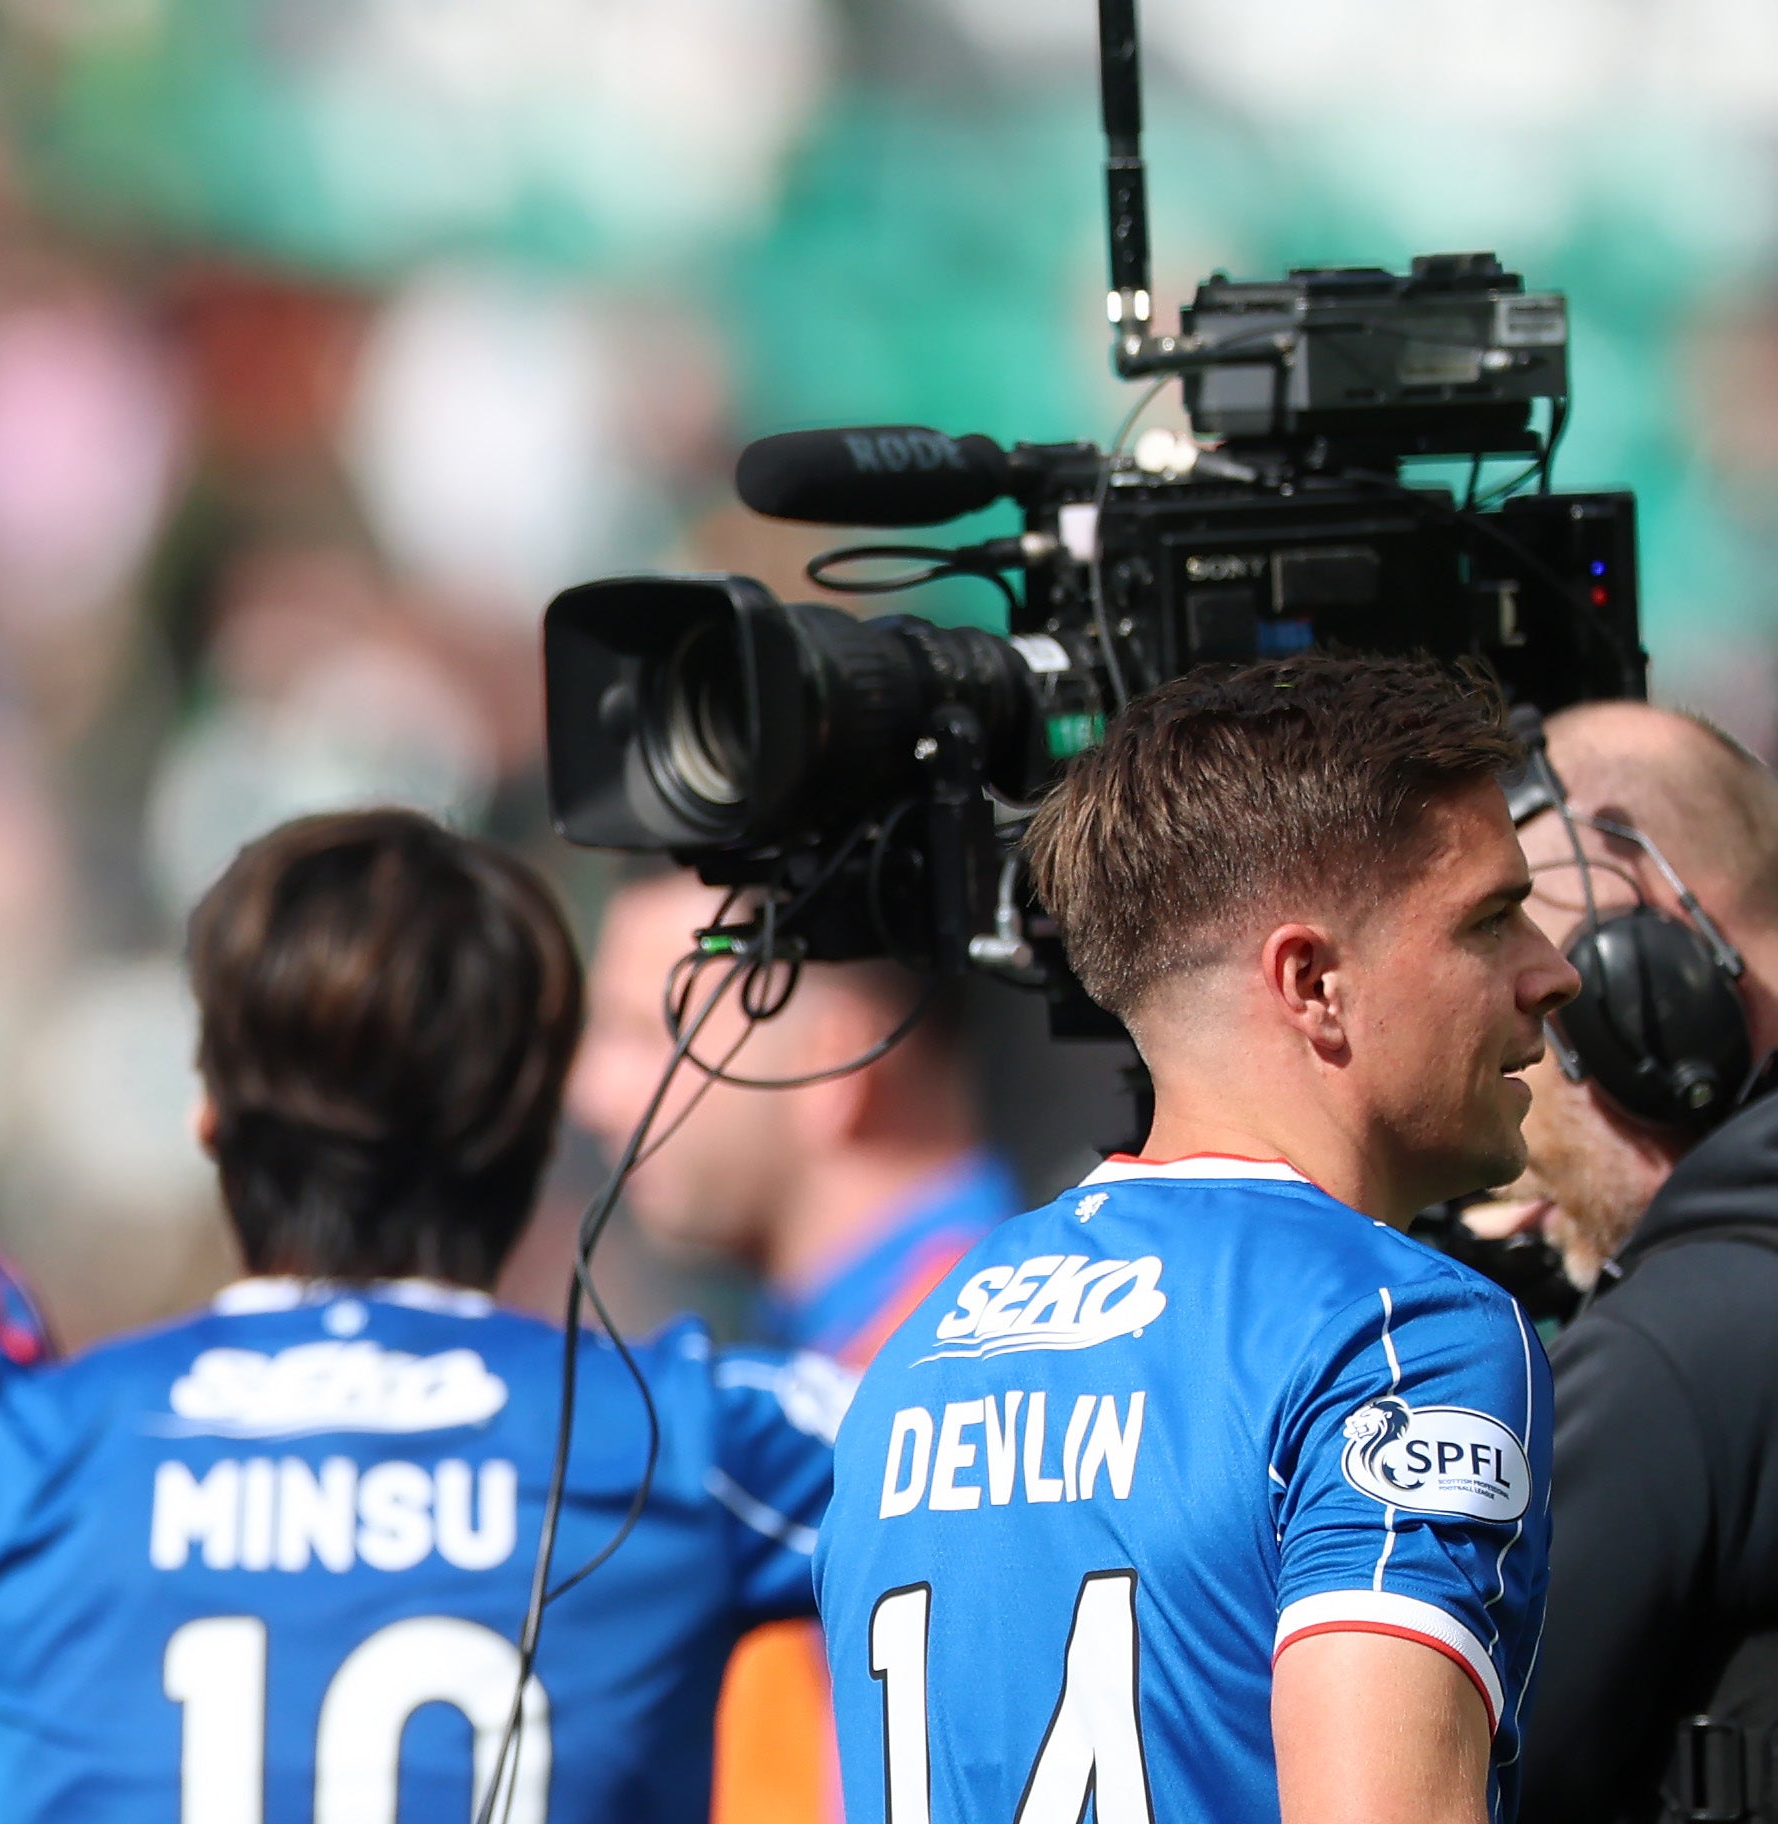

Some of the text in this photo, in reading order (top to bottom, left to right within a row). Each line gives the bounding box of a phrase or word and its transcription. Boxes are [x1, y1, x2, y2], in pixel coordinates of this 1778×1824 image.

[936, 1254, 1167, 1349] SEKO
[879, 1390, 1146, 1519] DEVLIN
[1405, 1439, 1511, 1489] SPFL
[149, 1458, 518, 1573] MINSU
